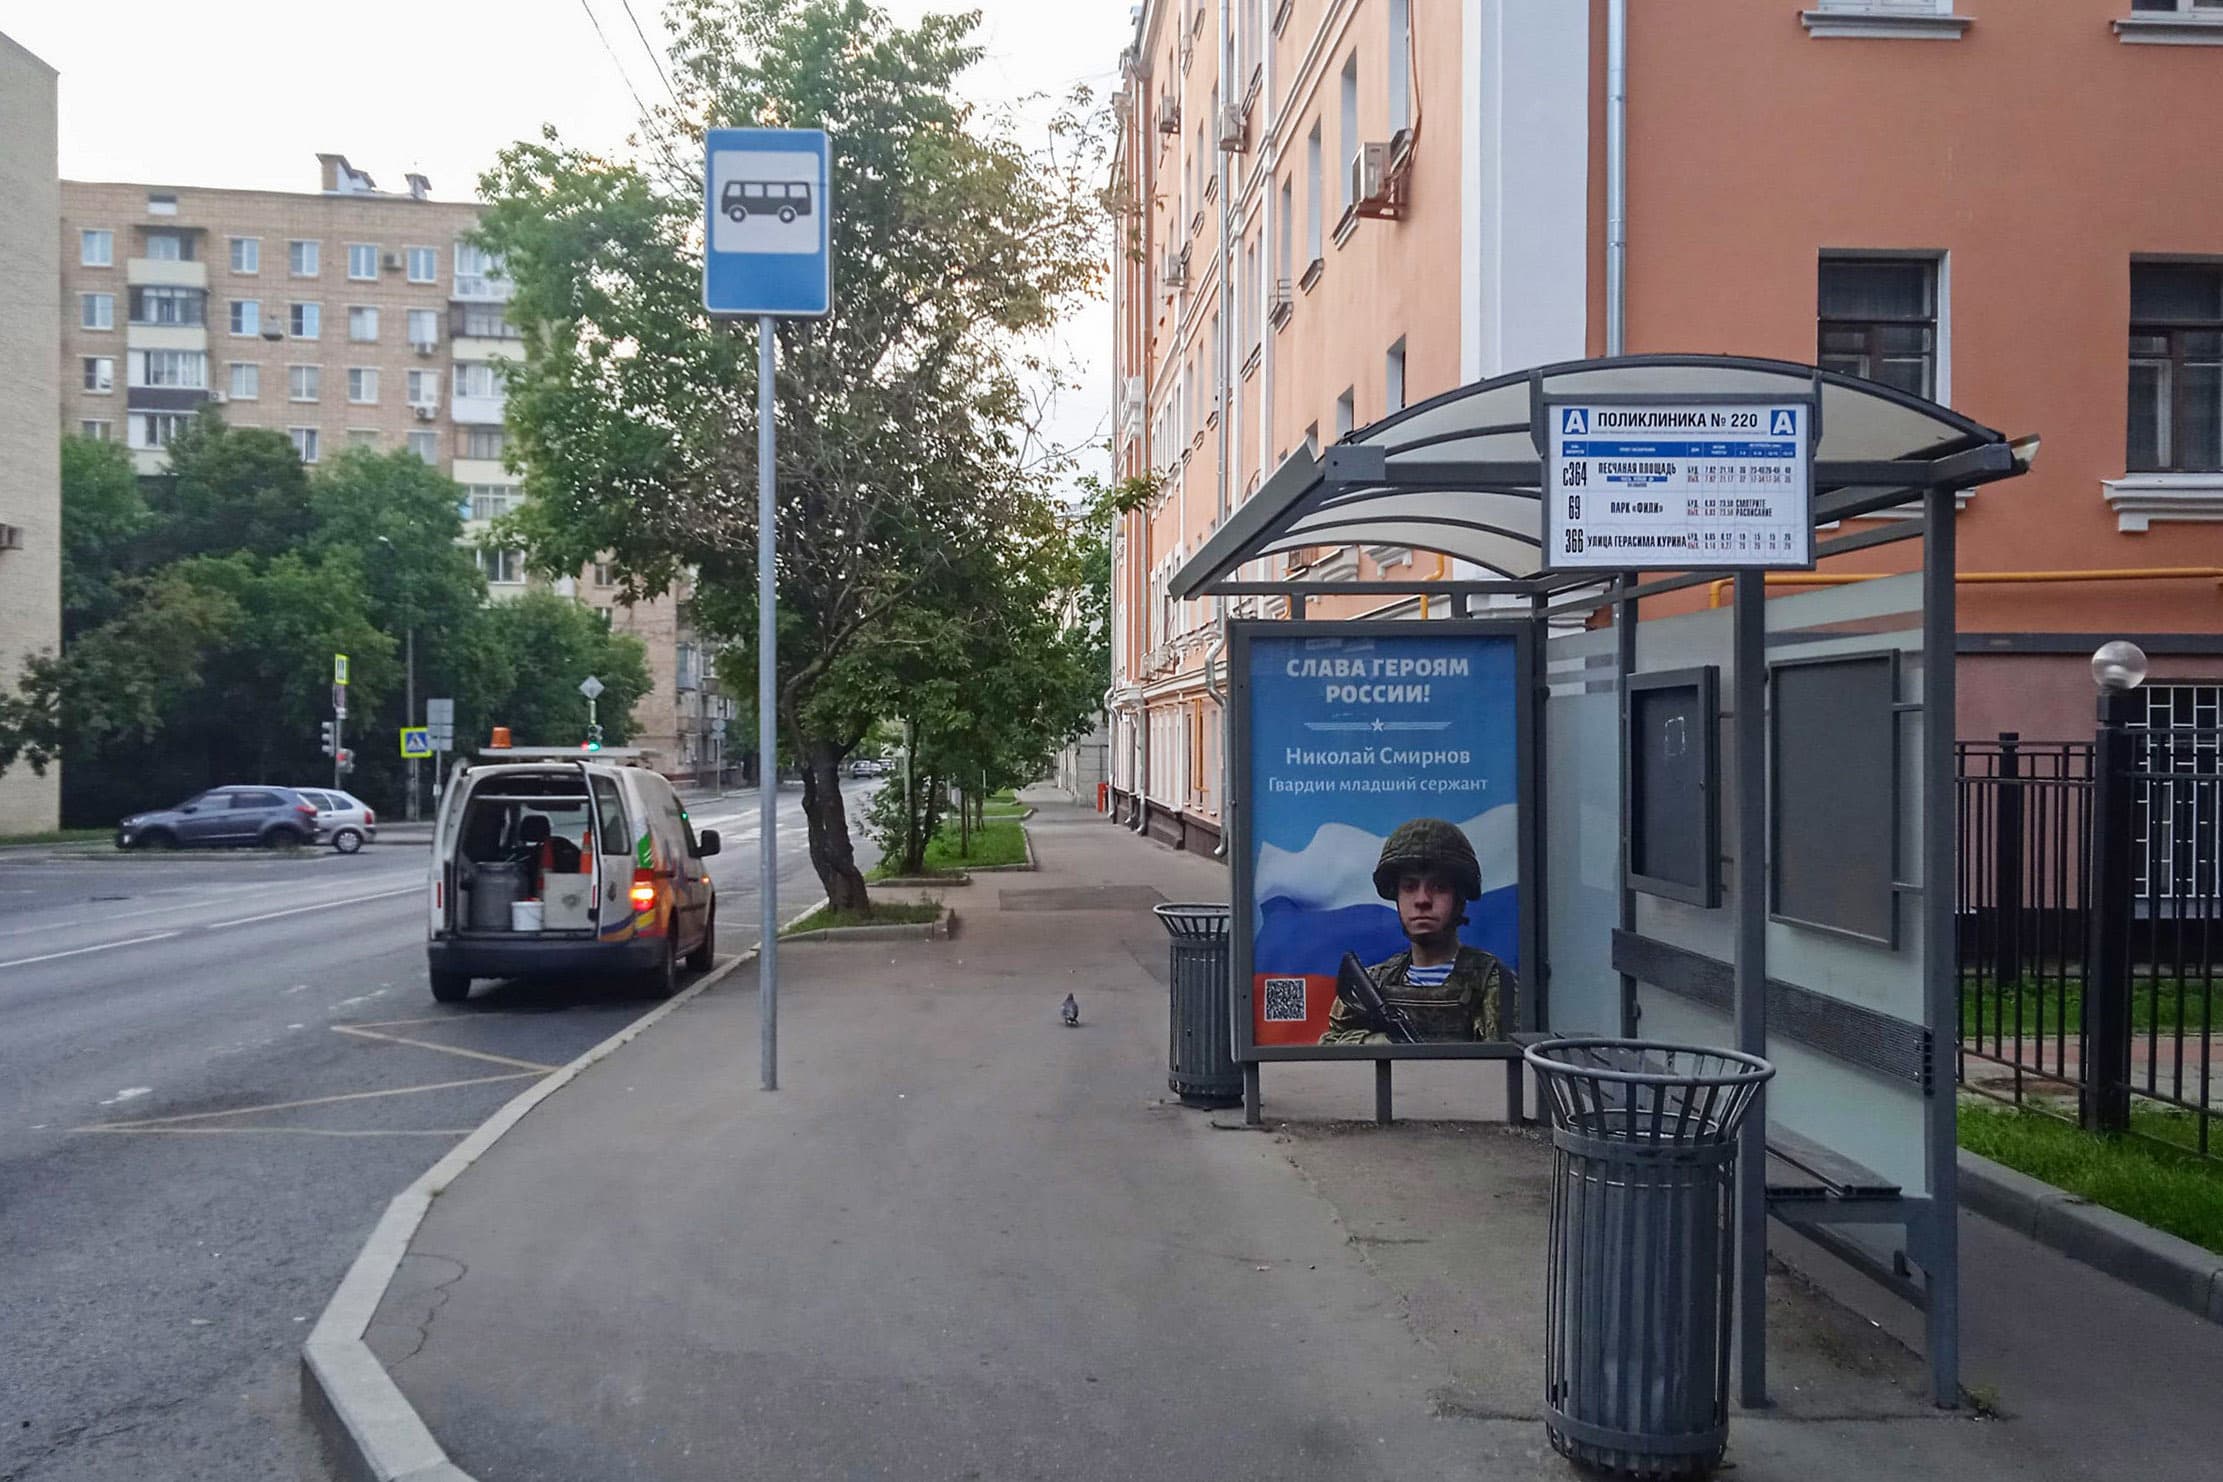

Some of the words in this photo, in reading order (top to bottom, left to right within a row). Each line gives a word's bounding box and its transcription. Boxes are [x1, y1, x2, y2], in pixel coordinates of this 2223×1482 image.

[1598, 412, 1706, 428] ПОЛИКЛИНИКА
[1711, 413, 1726, 428] №
[1731, 413, 1758, 428] 220
[1563, 461, 1587, 487] с364
[1598, 462, 1637, 474] ПЕСЧАНАЯ
[1638, 462, 1677, 475] ПЛОЩАДЬ
[1568, 495, 1581, 519] 69
[1610, 502, 1630, 513] ПАРК
[1736, 508, 1772, 517] РАСПИСАНИЕ
[1565, 528, 1584, 553] 366
[1587, 535, 1612, 548] УЛИЦА
[1614, 535, 1655, 547] ГЕРАСИМА
[1657, 535, 1687, 547] КУРИНА
[1286, 659, 1367, 677] СЛАВА
[1373, 658, 1469, 677] ГЕРОЯМ
[1326, 685, 1431, 703] РОССИИ!
[1286, 747, 1374, 765] Николай
[1380, 748, 1470, 767] Смирнов
[1269, 777, 1335, 794] Гвардии
[1339, 776, 1417, 792] младший
[1420, 778, 1488, 794] сержант
